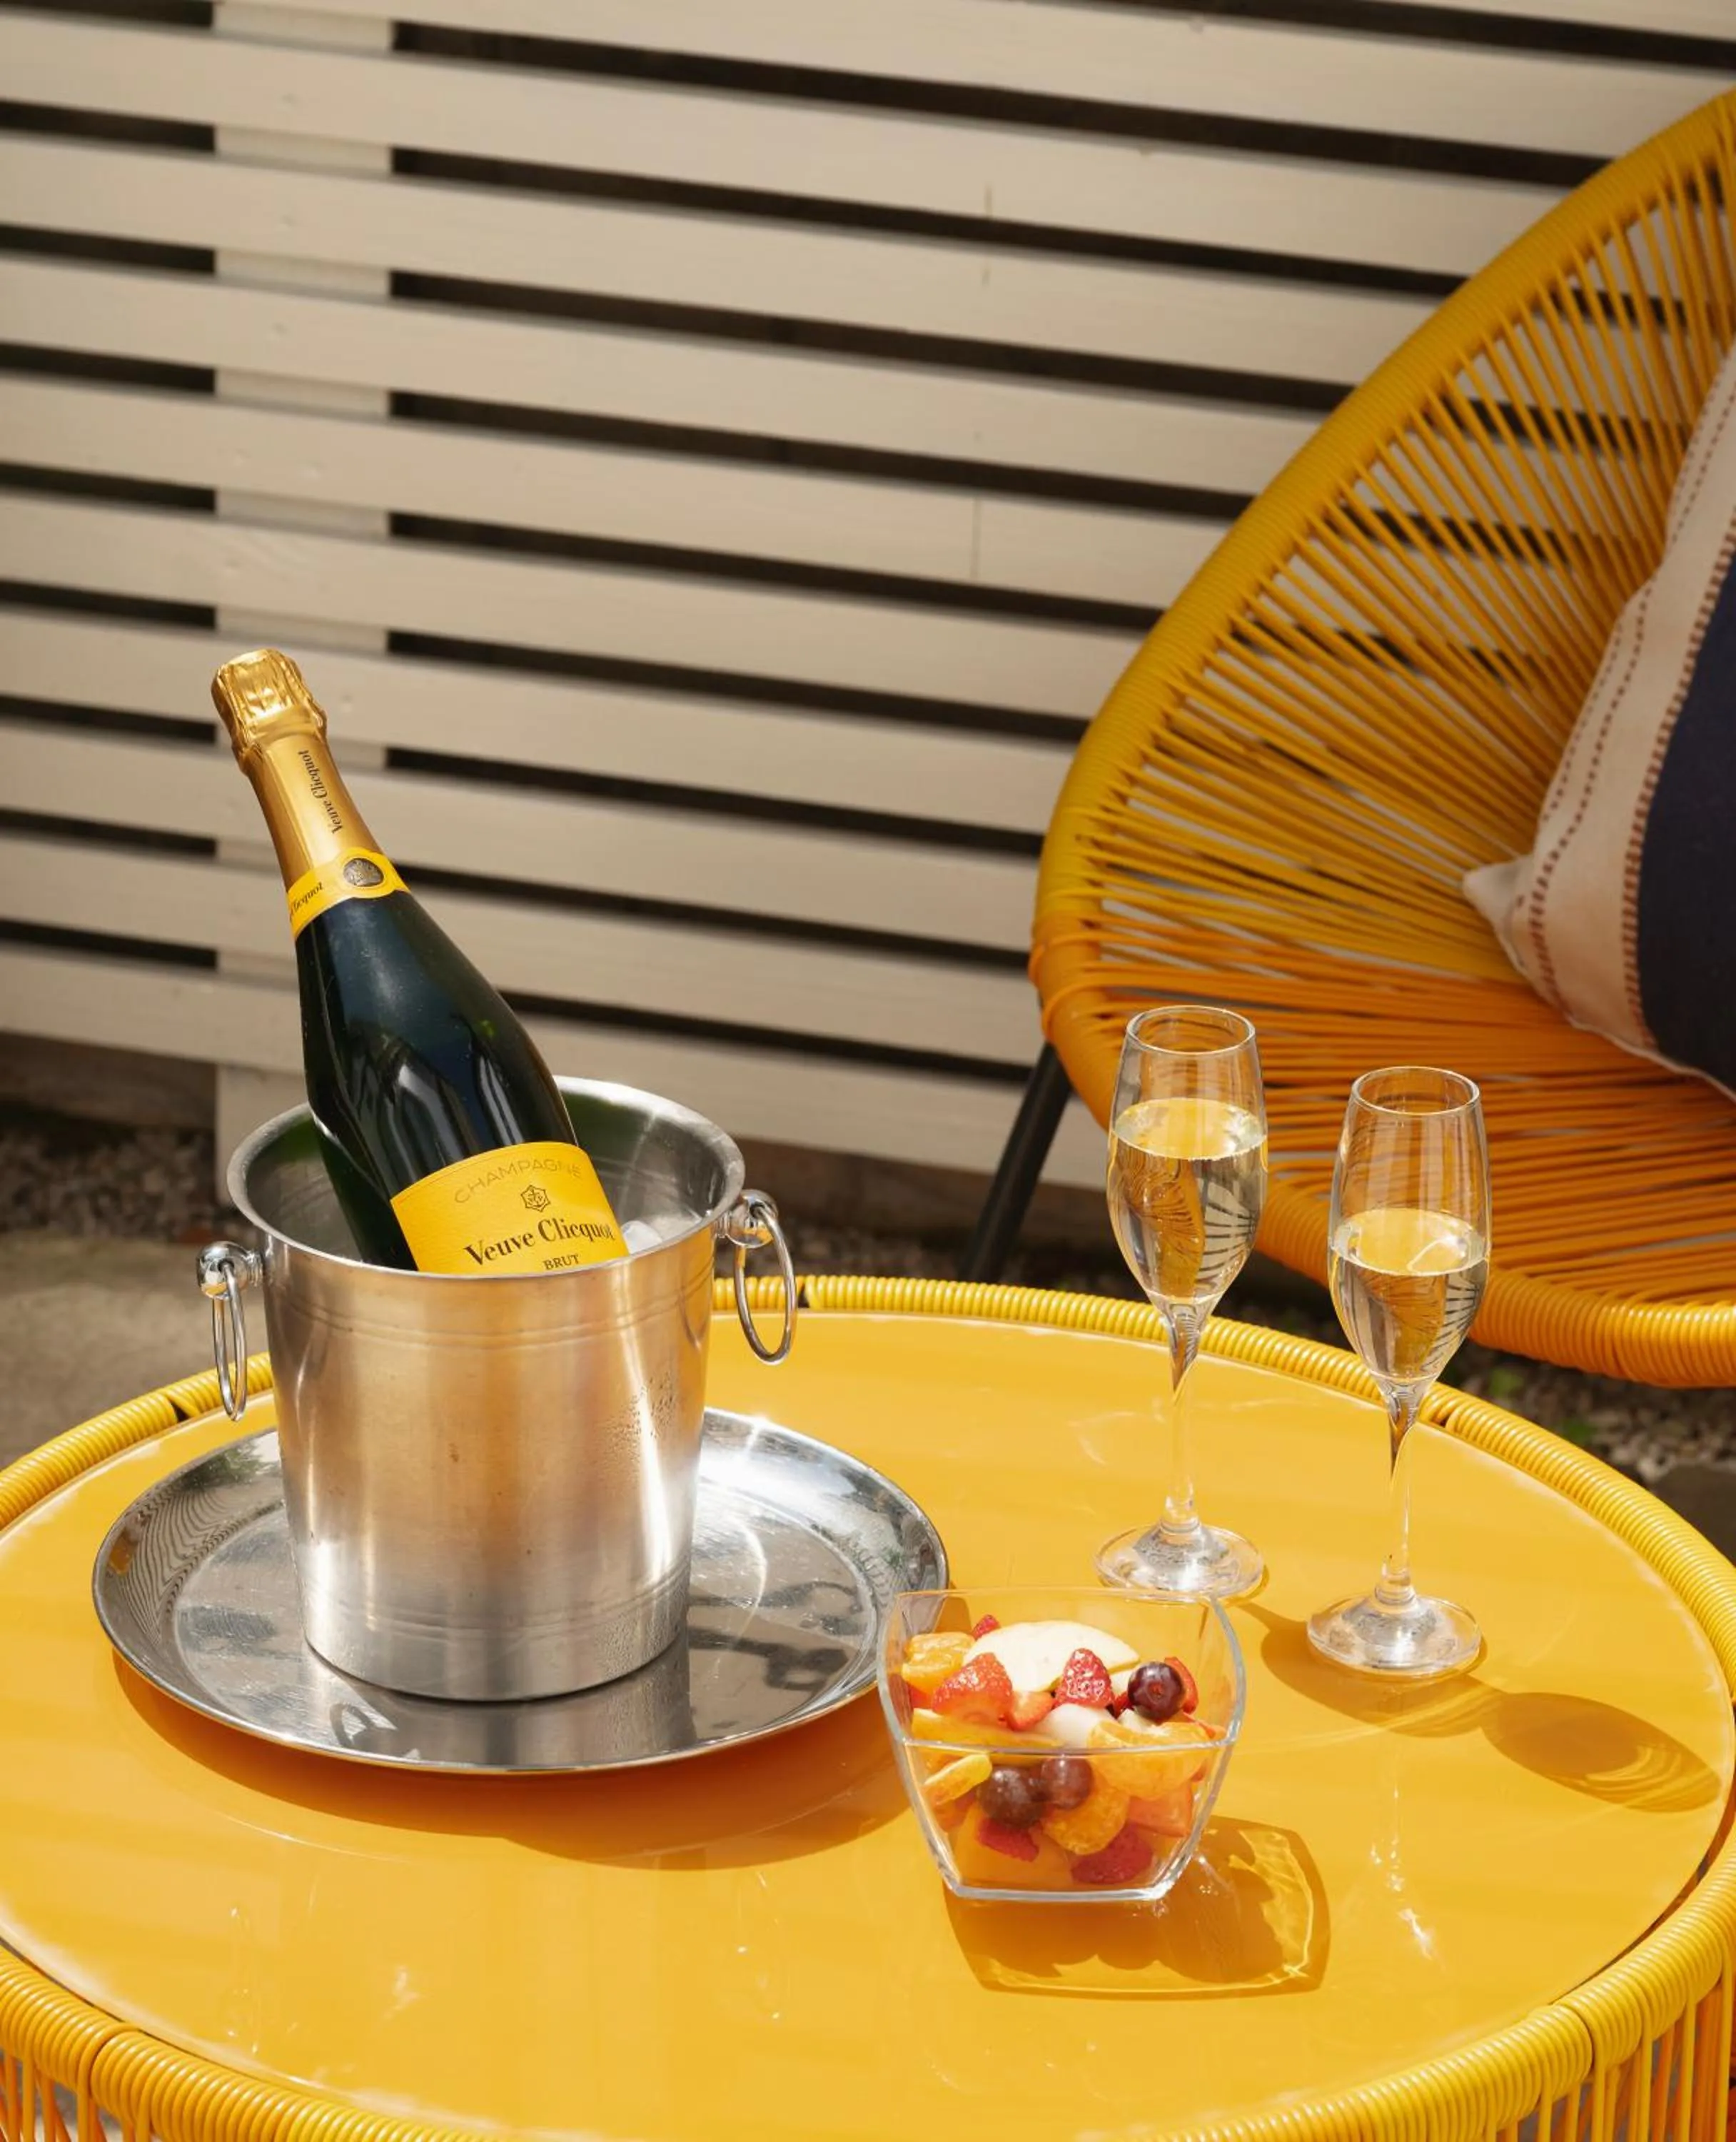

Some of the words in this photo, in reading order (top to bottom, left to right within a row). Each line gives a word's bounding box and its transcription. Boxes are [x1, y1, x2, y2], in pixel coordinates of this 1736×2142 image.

[298, 750, 328, 799] Clicquot
[323, 800, 343, 834] Veuve
[454, 1159, 582, 1204] CHAMPAGNE
[464, 1232, 536, 1267] Veuve
[538, 1217, 615, 1242] Clicquot
[543, 1254, 579, 1270] BRUT
